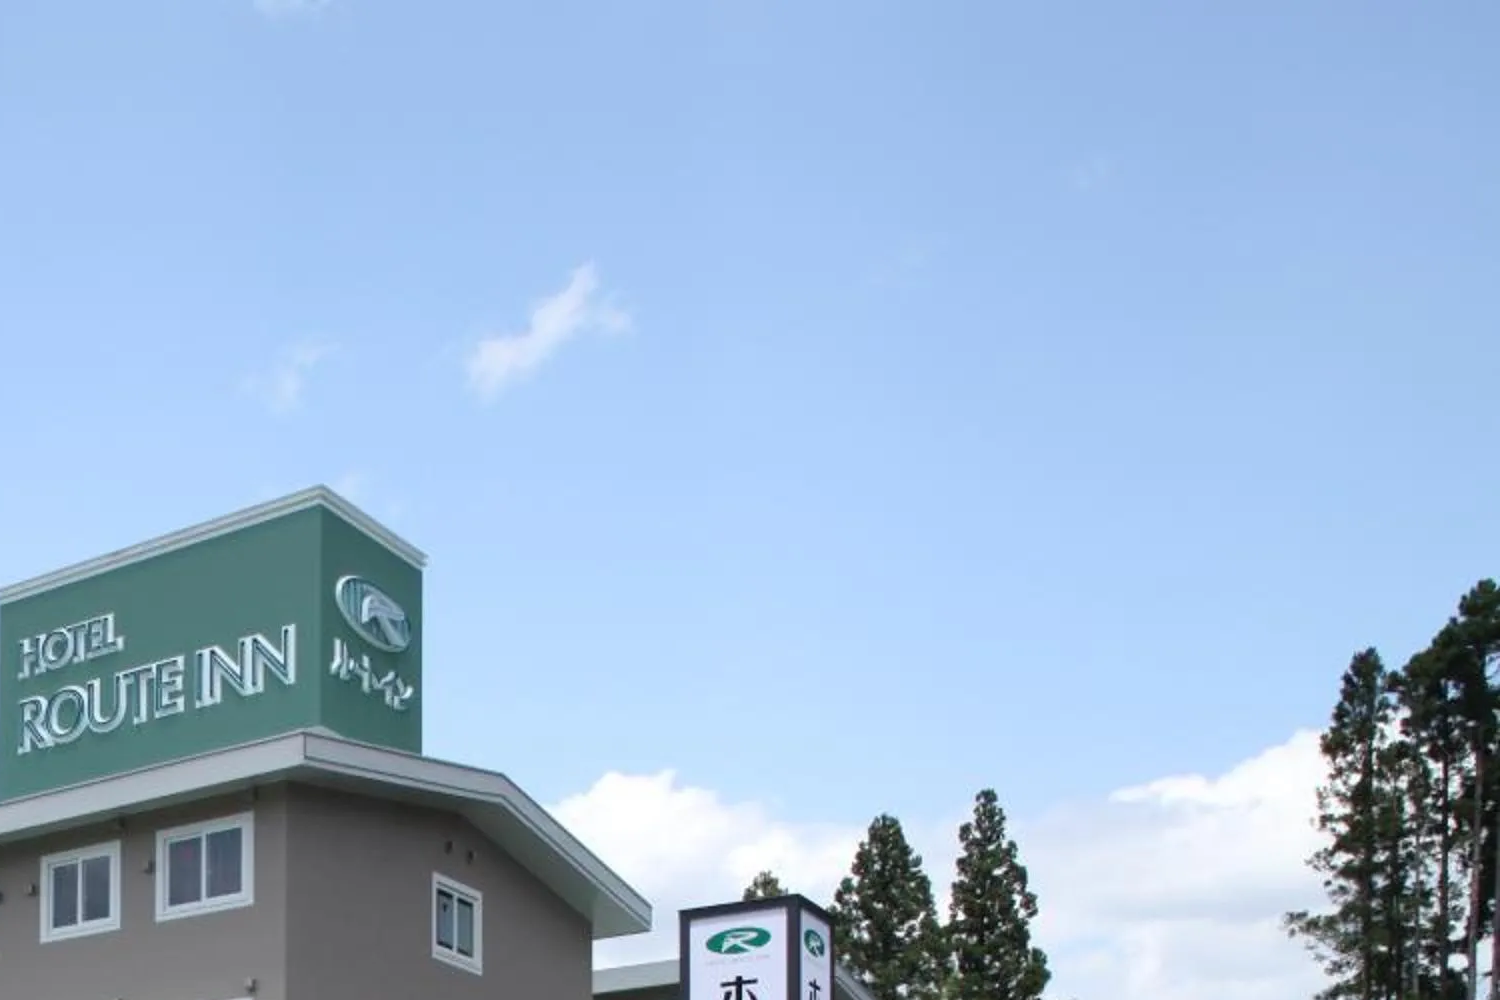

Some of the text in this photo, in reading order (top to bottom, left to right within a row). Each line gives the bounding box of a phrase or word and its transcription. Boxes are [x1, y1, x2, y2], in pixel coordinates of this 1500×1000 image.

[17, 613, 125, 680] HOTEL
[329, 637, 414, 711] ルートイン
[17, 623, 297, 756] ROUTE INN
